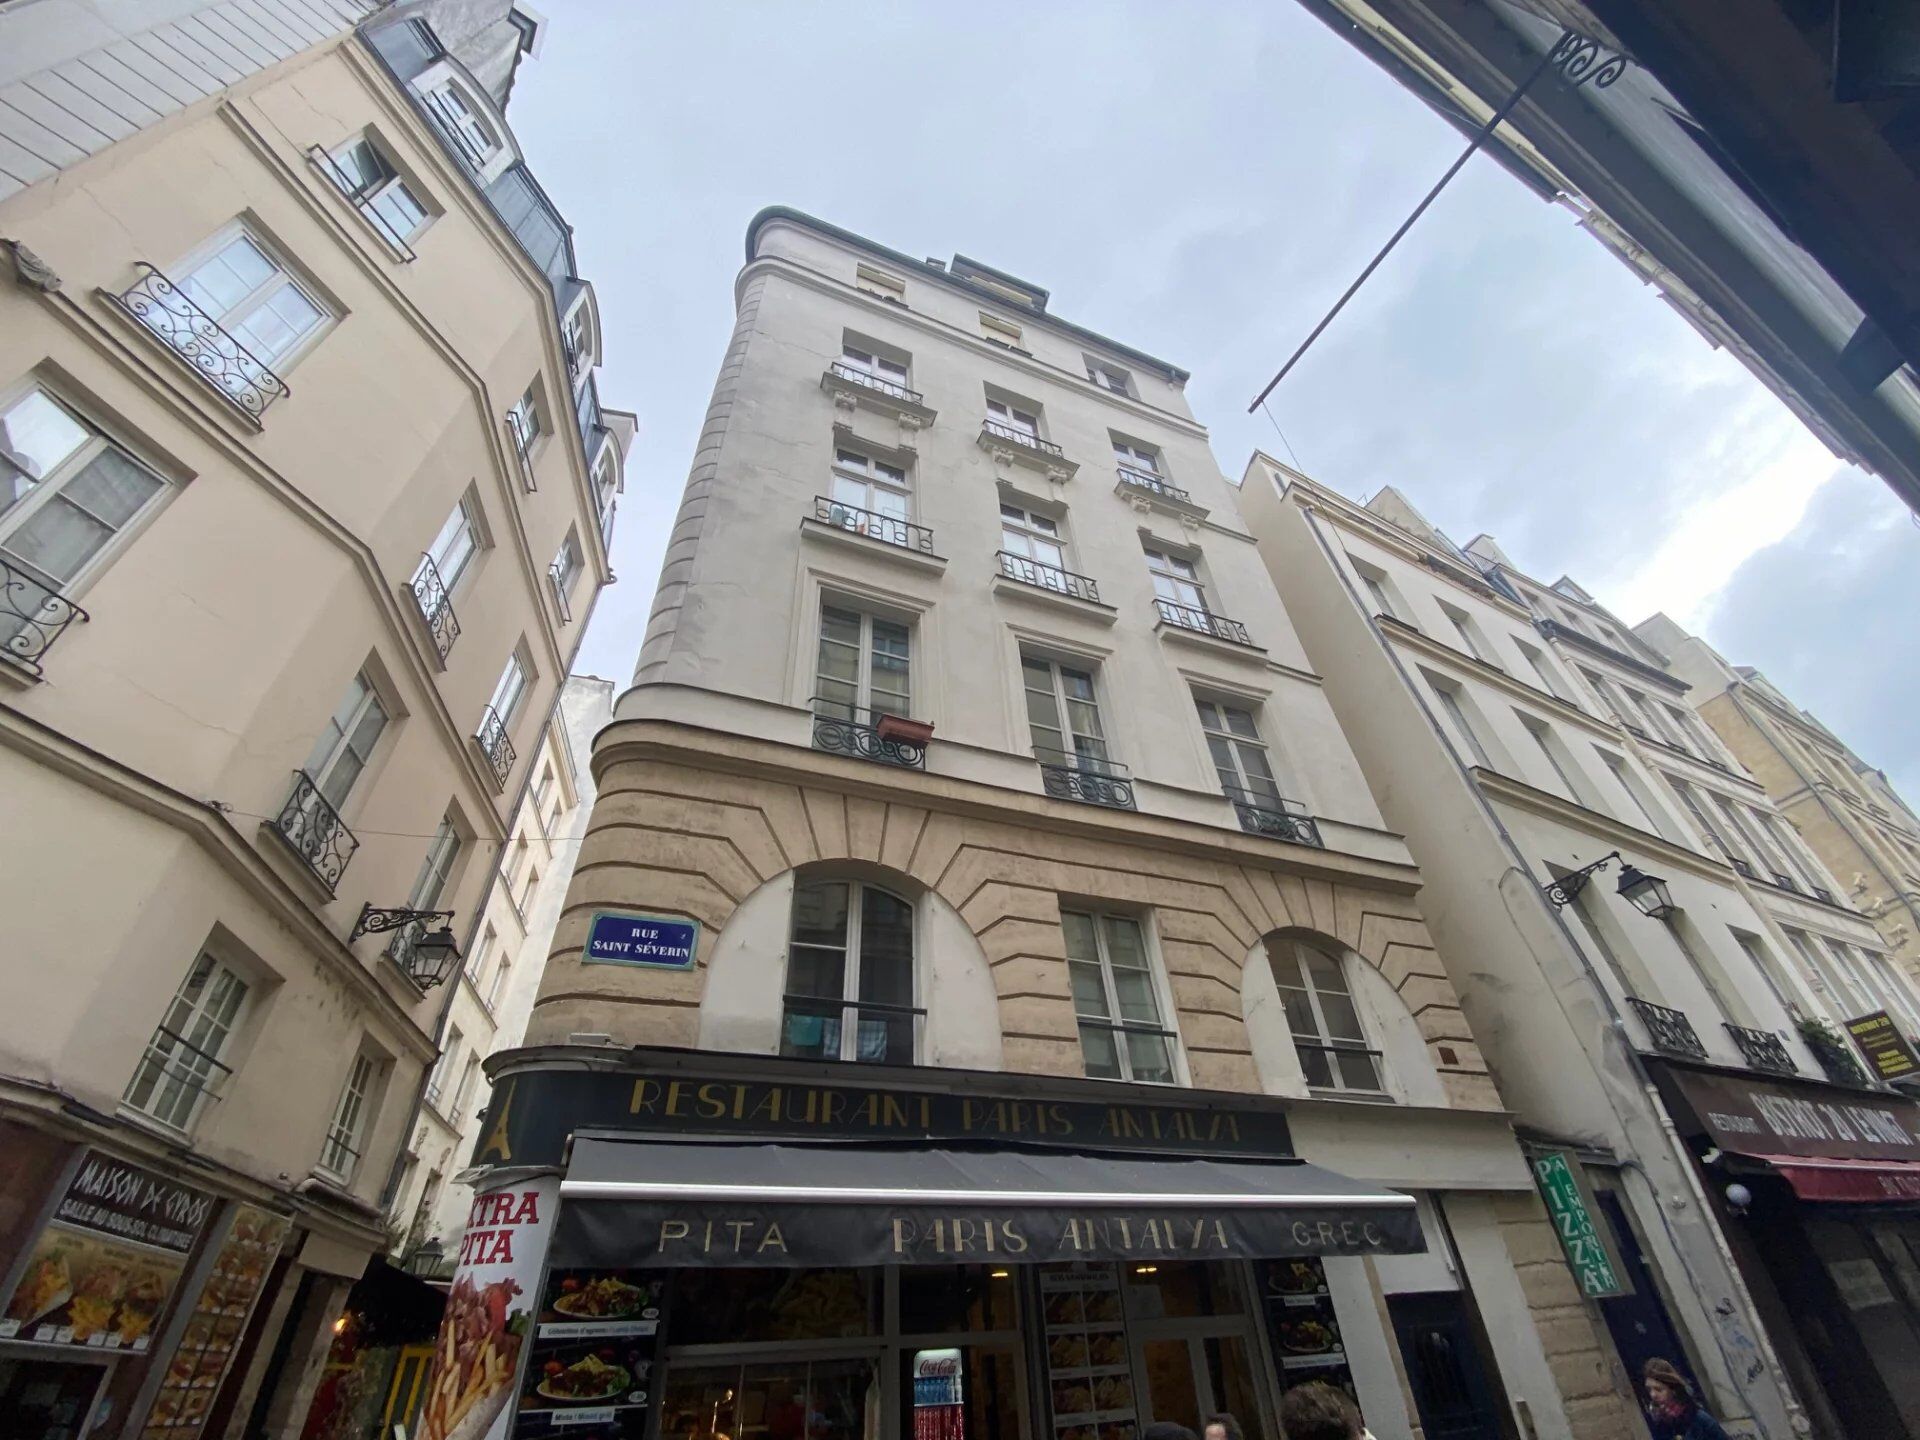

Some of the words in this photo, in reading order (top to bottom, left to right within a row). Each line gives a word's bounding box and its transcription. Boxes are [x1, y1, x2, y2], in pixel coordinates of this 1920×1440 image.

[592, 940, 631, 953] SAINT
[634, 941, 690, 957] SÉVERIN
[631, 928, 659, 940] RUE
[629, 1079, 934, 1129] RESTAURANT
[962, 1099, 1074, 1135] PARIS
[1100, 1107, 1240, 1142] ANTALYA
[60, 1198, 96, 1222] SALLE
[74, 1159, 144, 1205] MAISON
[140, 1182, 167, 1213] DE
[165, 1189, 210, 1228] GYROS
[657, 1220, 788, 1253] PITA
[893, 1218, 1028, 1253] PARIS
[1058, 1217, 1229, 1250] ANTALYA
[1291, 1220, 1382, 1247] GREC
[1534, 1160, 1604, 1294] PIZZA
[1565, 1184, 1616, 1289] EMPORTER
